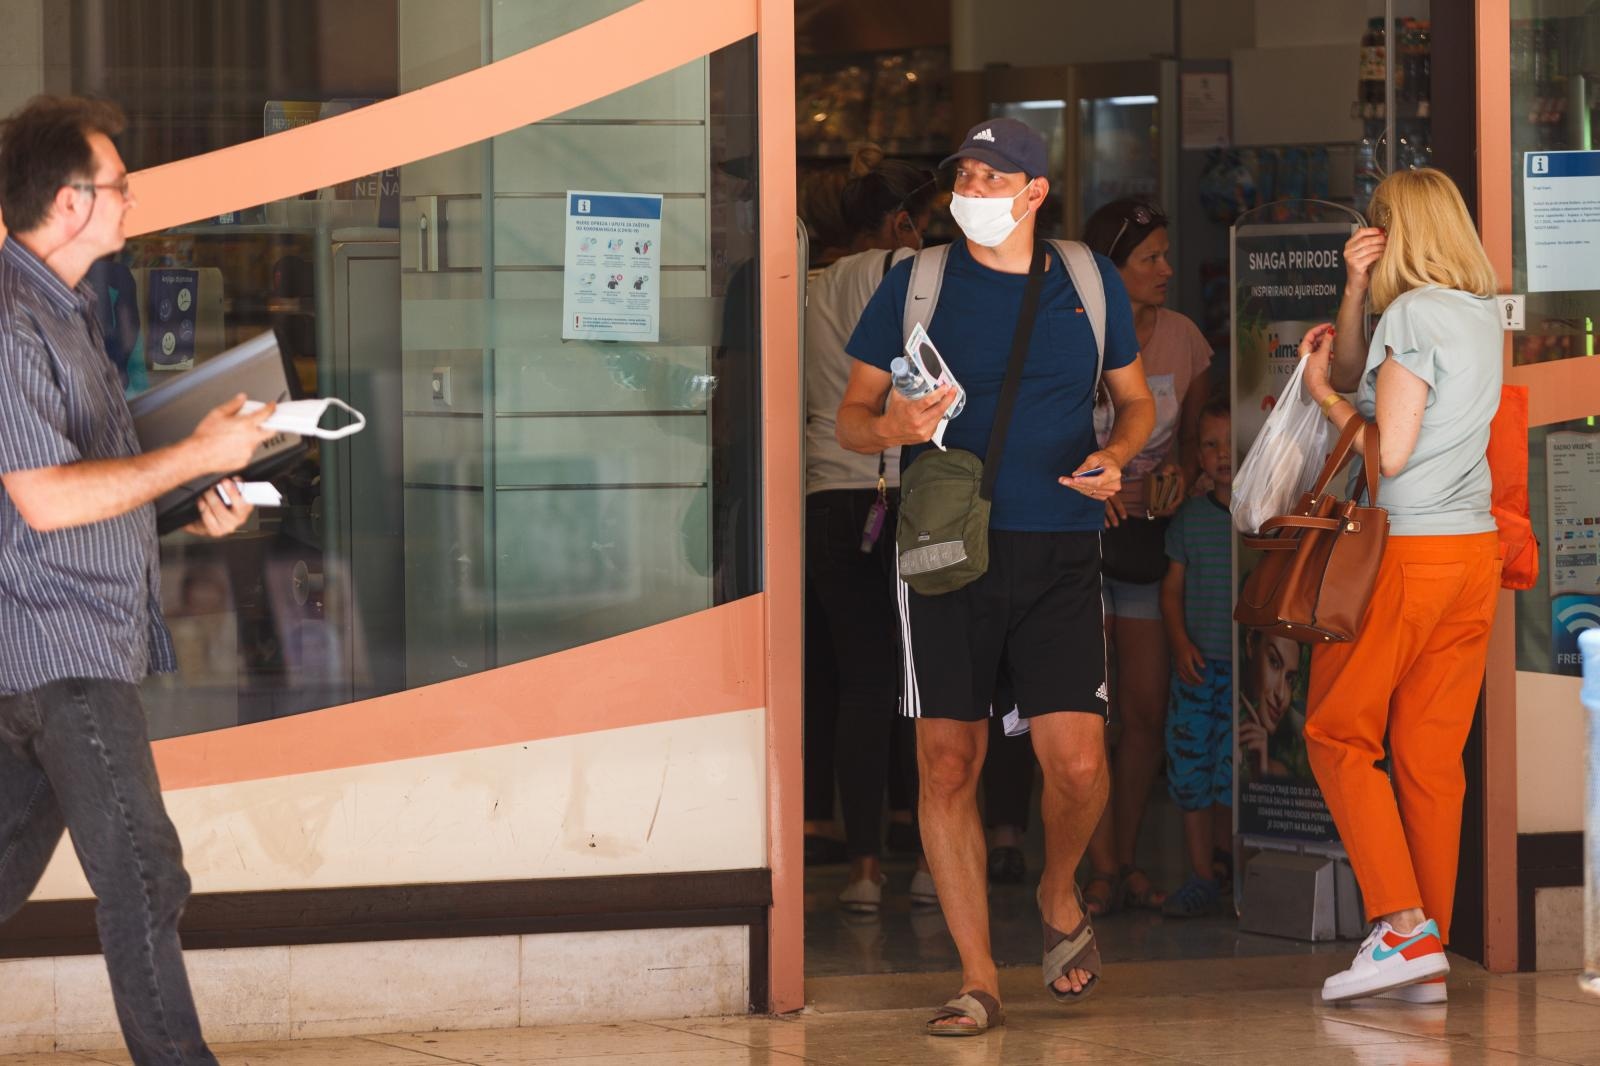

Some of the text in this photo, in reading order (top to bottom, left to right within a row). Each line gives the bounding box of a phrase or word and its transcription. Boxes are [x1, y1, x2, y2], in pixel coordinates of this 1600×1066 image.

[1249, 250, 1338, 270] SNAGA PRIRODE
[1251, 284, 1337, 299] INSPIRIRANO AJURVEDOM
[1557, 653, 1584, 664] FREE
